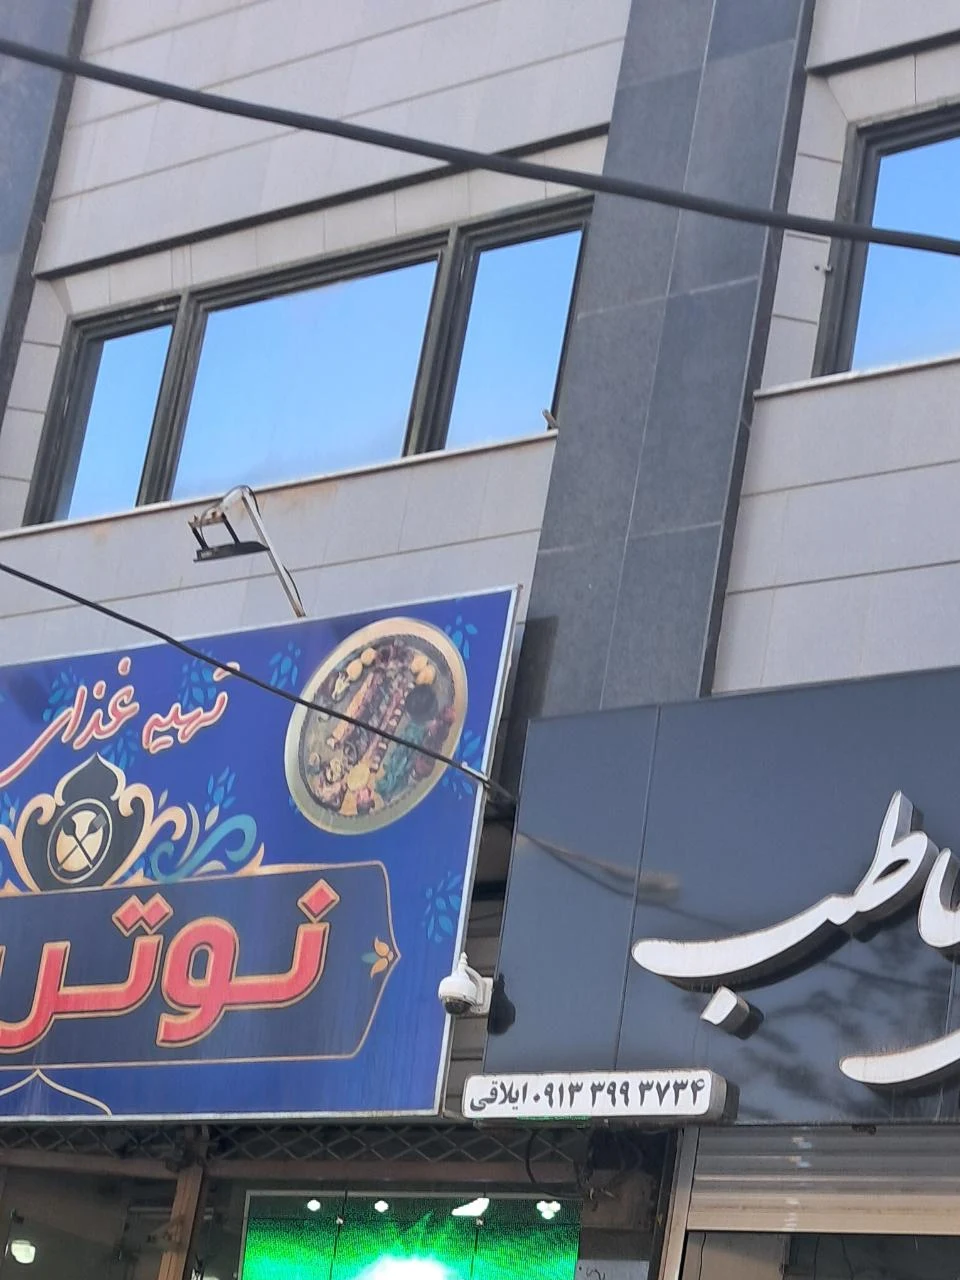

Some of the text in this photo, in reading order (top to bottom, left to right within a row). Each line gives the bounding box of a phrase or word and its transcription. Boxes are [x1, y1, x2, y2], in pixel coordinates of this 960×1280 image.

[142, 662, 240, 754] تهیه
[470, 1077, 706, 1112] ۰۹۱۳ ۳۹۹ ۳۷۳۴ ایلاقی
